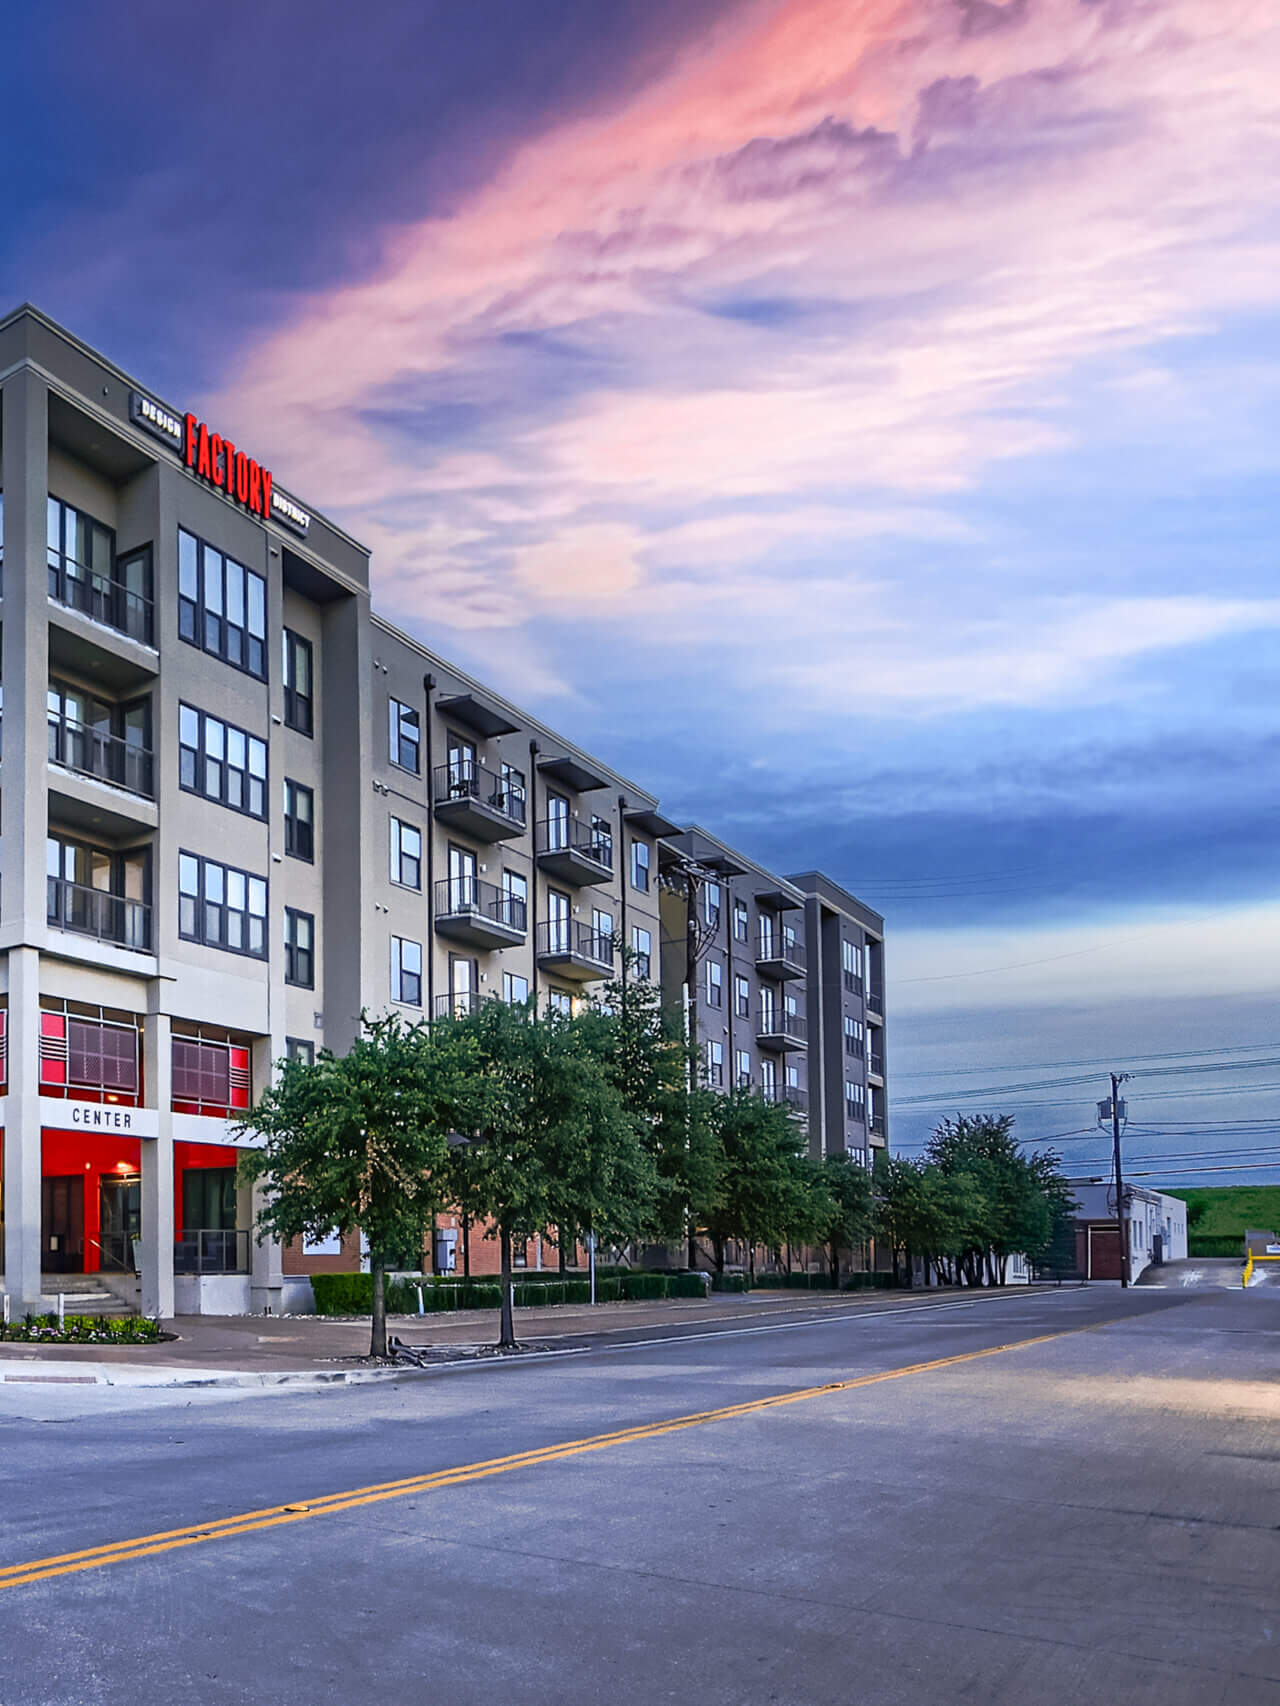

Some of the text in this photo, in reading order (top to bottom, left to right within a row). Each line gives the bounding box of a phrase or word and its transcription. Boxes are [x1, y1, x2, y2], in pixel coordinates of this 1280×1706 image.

[141, 399, 310, 528] DESIGN FACTORY DISTRICT
[72, 1108, 132, 1128] CENTER
